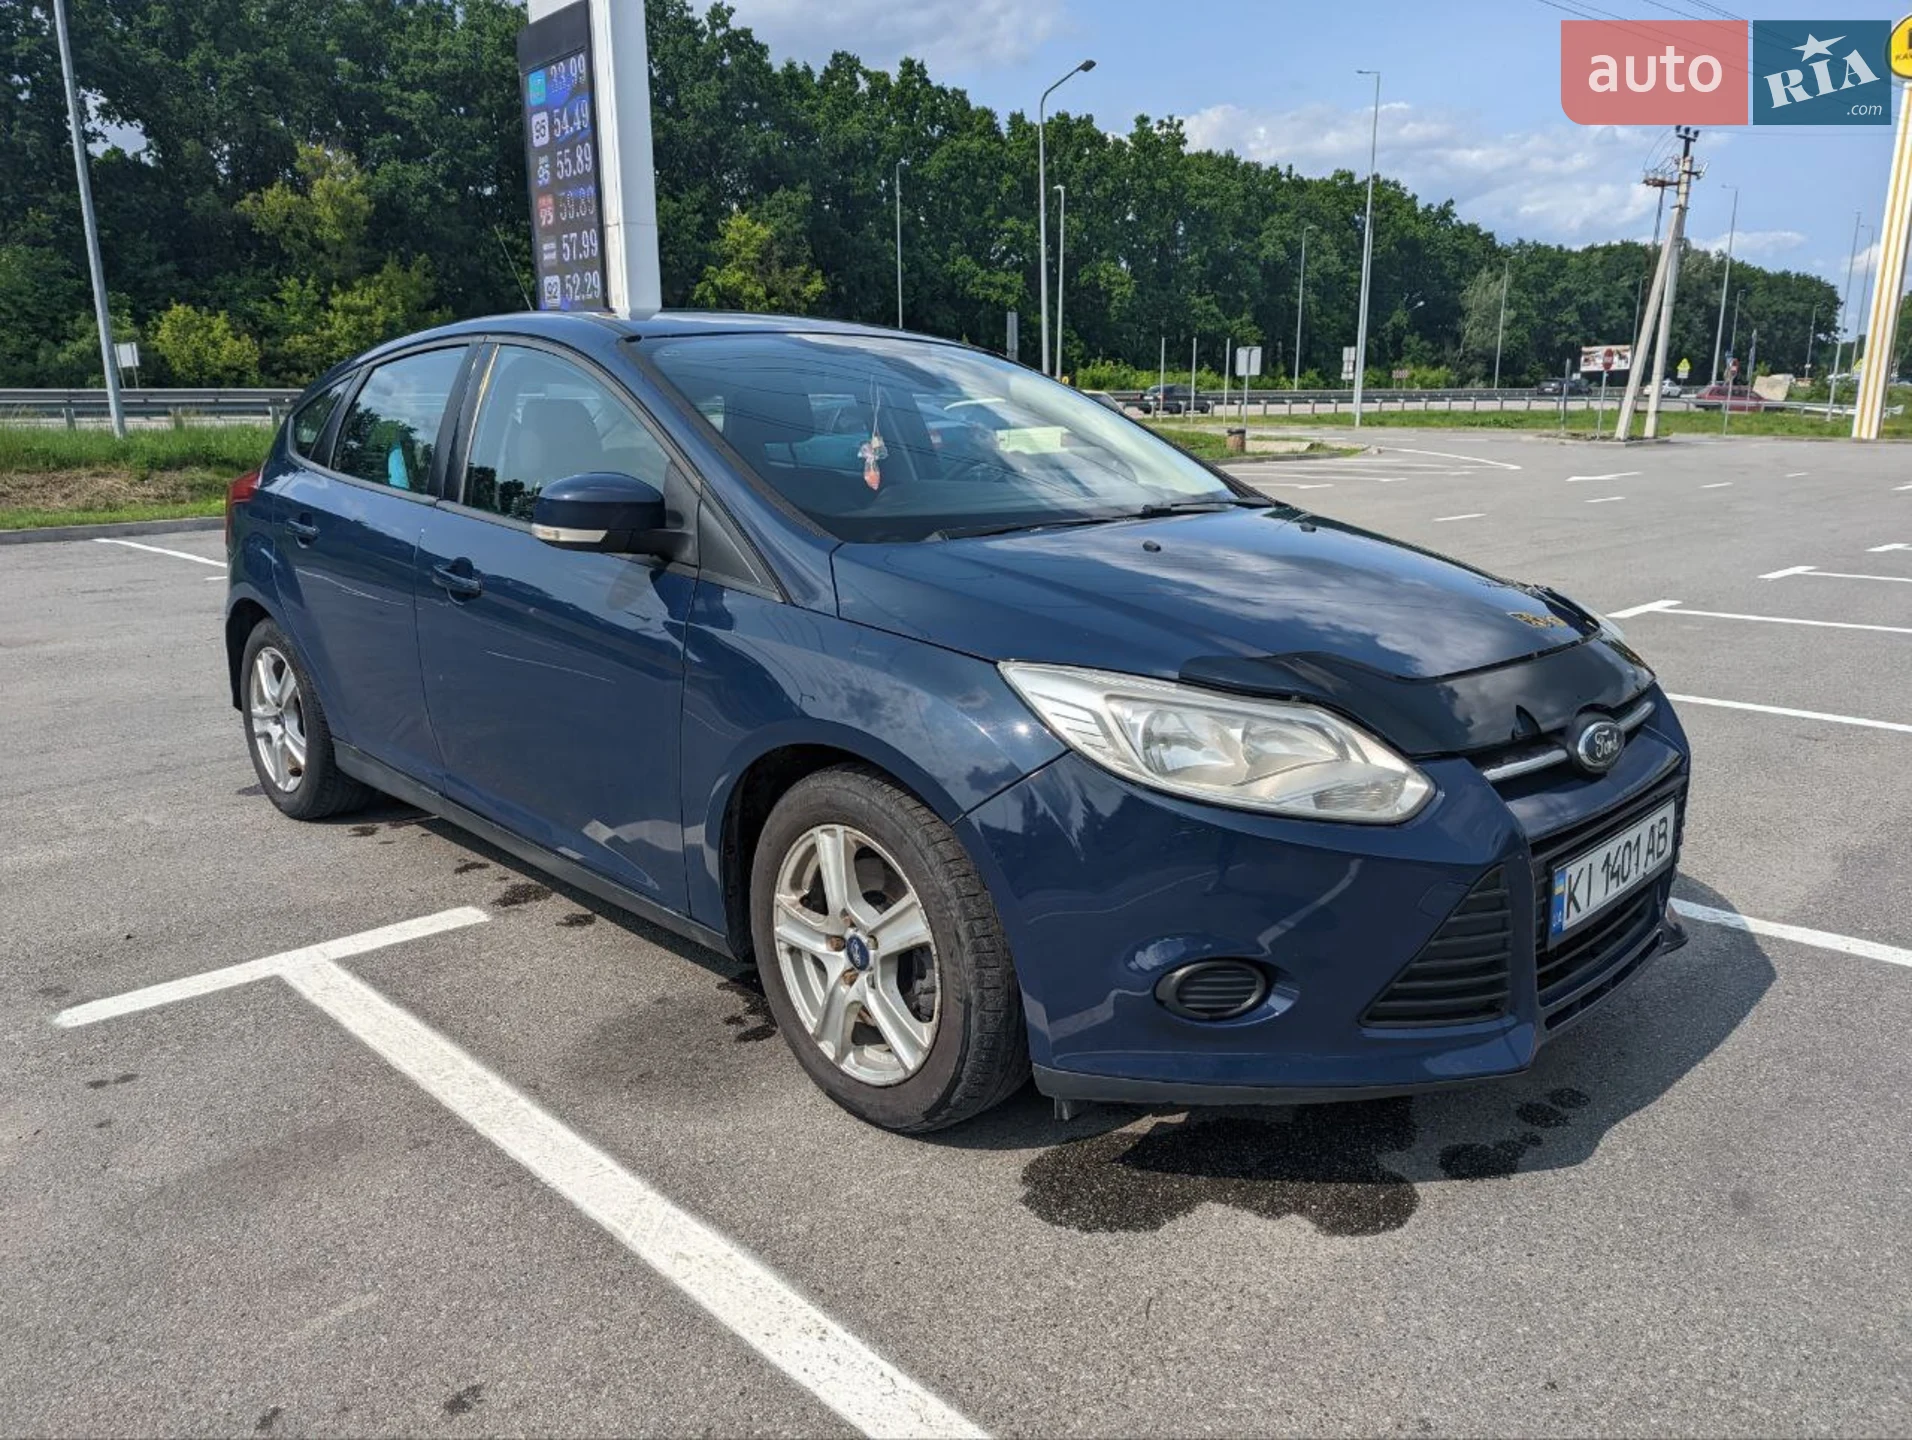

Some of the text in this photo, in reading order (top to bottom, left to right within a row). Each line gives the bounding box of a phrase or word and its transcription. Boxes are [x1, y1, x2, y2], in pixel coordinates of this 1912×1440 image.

[553, 99, 589, 137] 54.49
[556, 142, 592, 180] 55.89
[562, 228, 598, 262] 57.99
[565, 270, 600, 302] 52.29
[1601, 833, 1641, 896] 1401
[1644, 817, 1668, 868] AB
